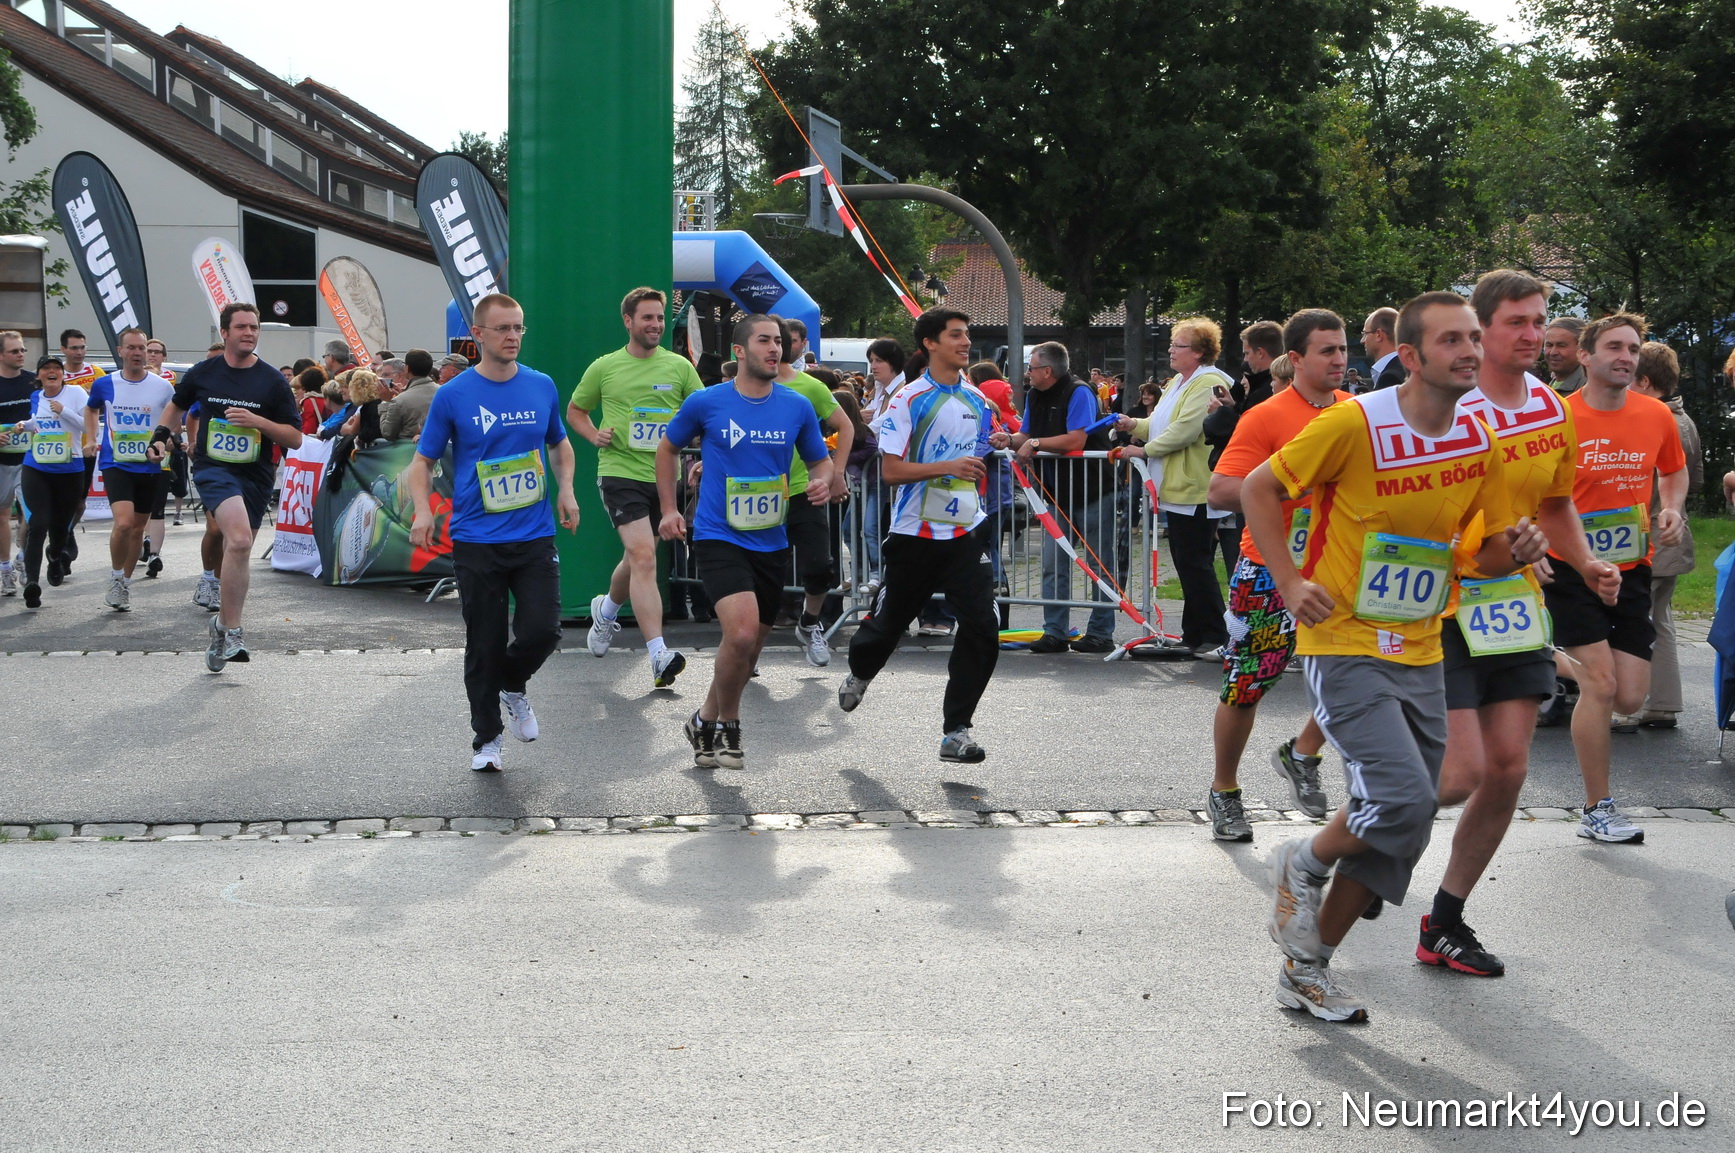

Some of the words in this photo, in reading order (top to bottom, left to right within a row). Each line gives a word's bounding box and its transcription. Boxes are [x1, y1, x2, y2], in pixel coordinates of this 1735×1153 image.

[207, 396, 261, 409] energiegeladen
[114, 412, 151, 427] TeVi
[501, 411, 536, 421] PLAST
[37, 420, 62, 429] TeVi
[750, 430, 786, 440] PLAST
[37, 442, 64, 455] 676
[118, 442, 146, 454] 680
[213, 433, 249, 453] 289
[1525, 432, 1567, 458] BÖGL
[1583, 449, 1647, 464] Fischer
[1590, 463, 1642, 471] AUTOMOBILE
[484, 471, 538, 499] 1178
[1375, 473, 1434, 497] MAX
[1440, 461, 1487, 488] BÖGL
[730, 494, 779, 516] 1161
[944, 497, 959, 517] 4
[1368, 564, 1435, 603] 410
[1367, 599, 1402, 610] Christian
[1469, 600, 1531, 636] 453
[1484, 635, 1512, 643] Richard
